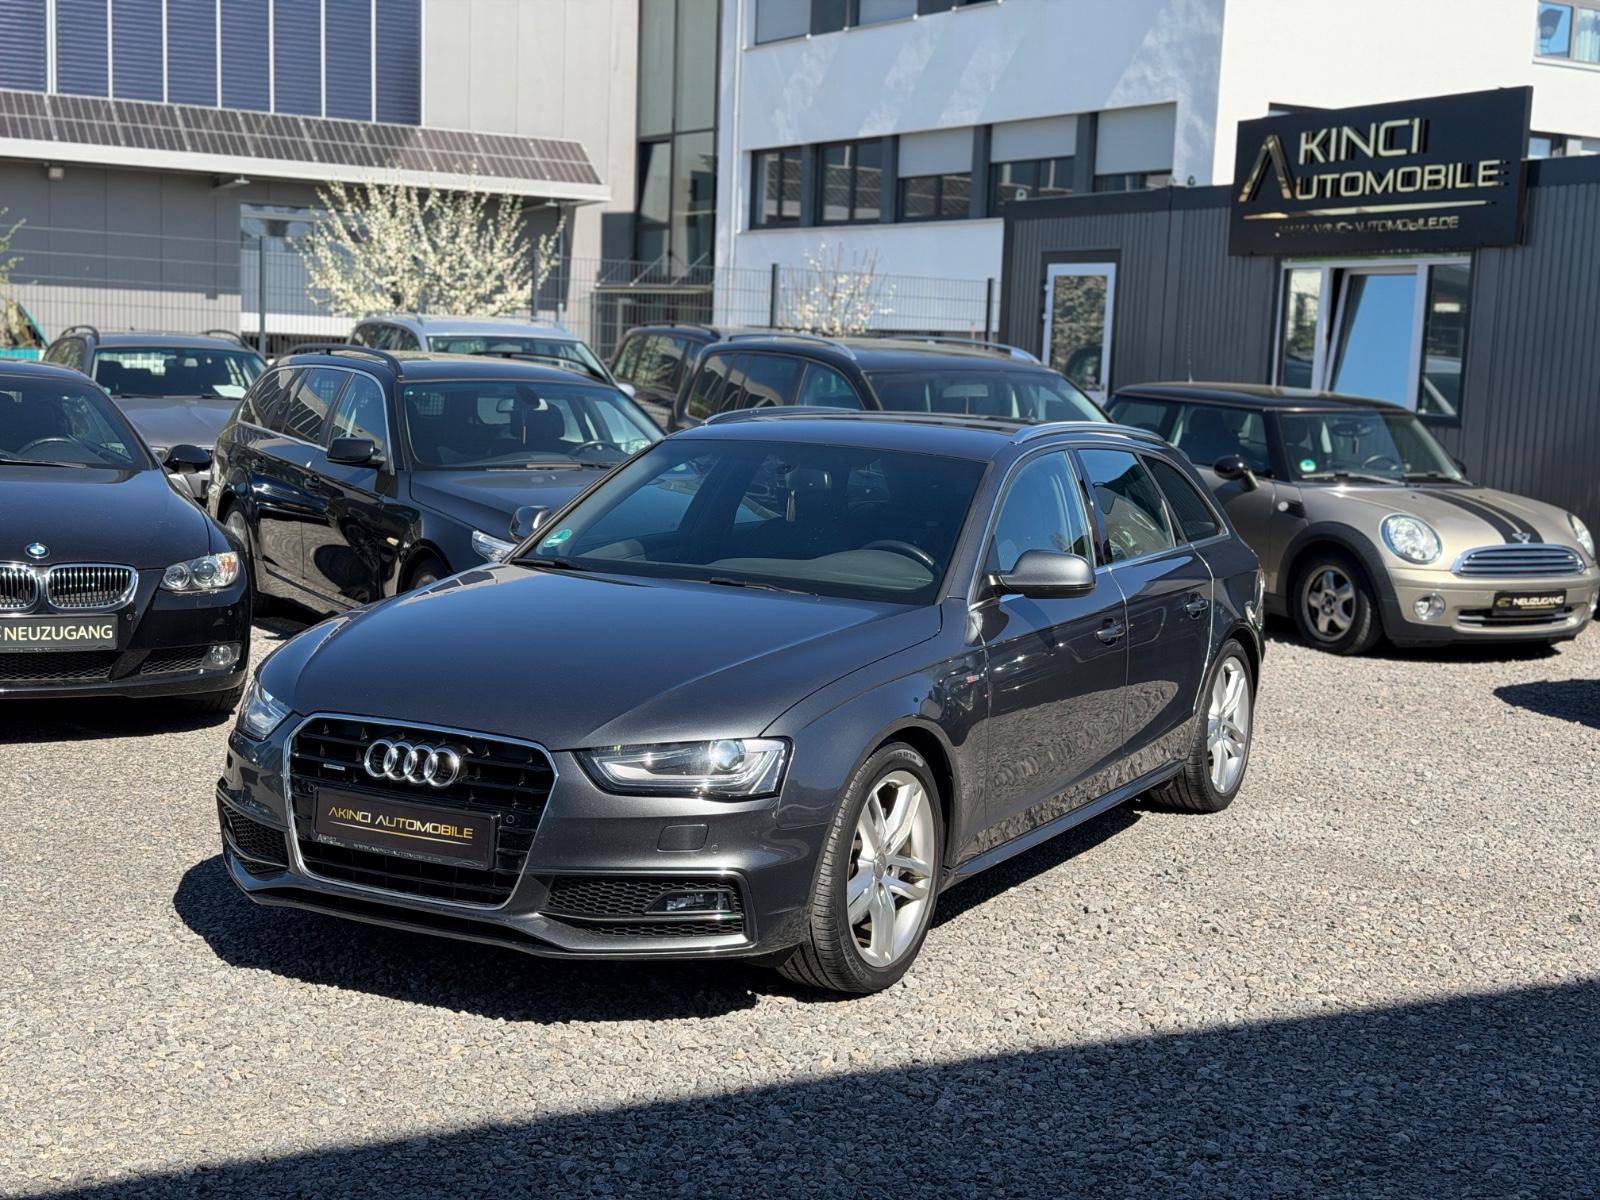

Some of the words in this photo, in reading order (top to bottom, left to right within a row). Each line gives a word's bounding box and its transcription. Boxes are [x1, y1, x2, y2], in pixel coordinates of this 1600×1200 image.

[1512, 596, 1564, 606] NEUZUGANG
[4, 625, 113, 641] NEUZUGANG
[328, 806, 371, 823] AKINCI
[375, 814, 474, 839] AUTOMOBILE
